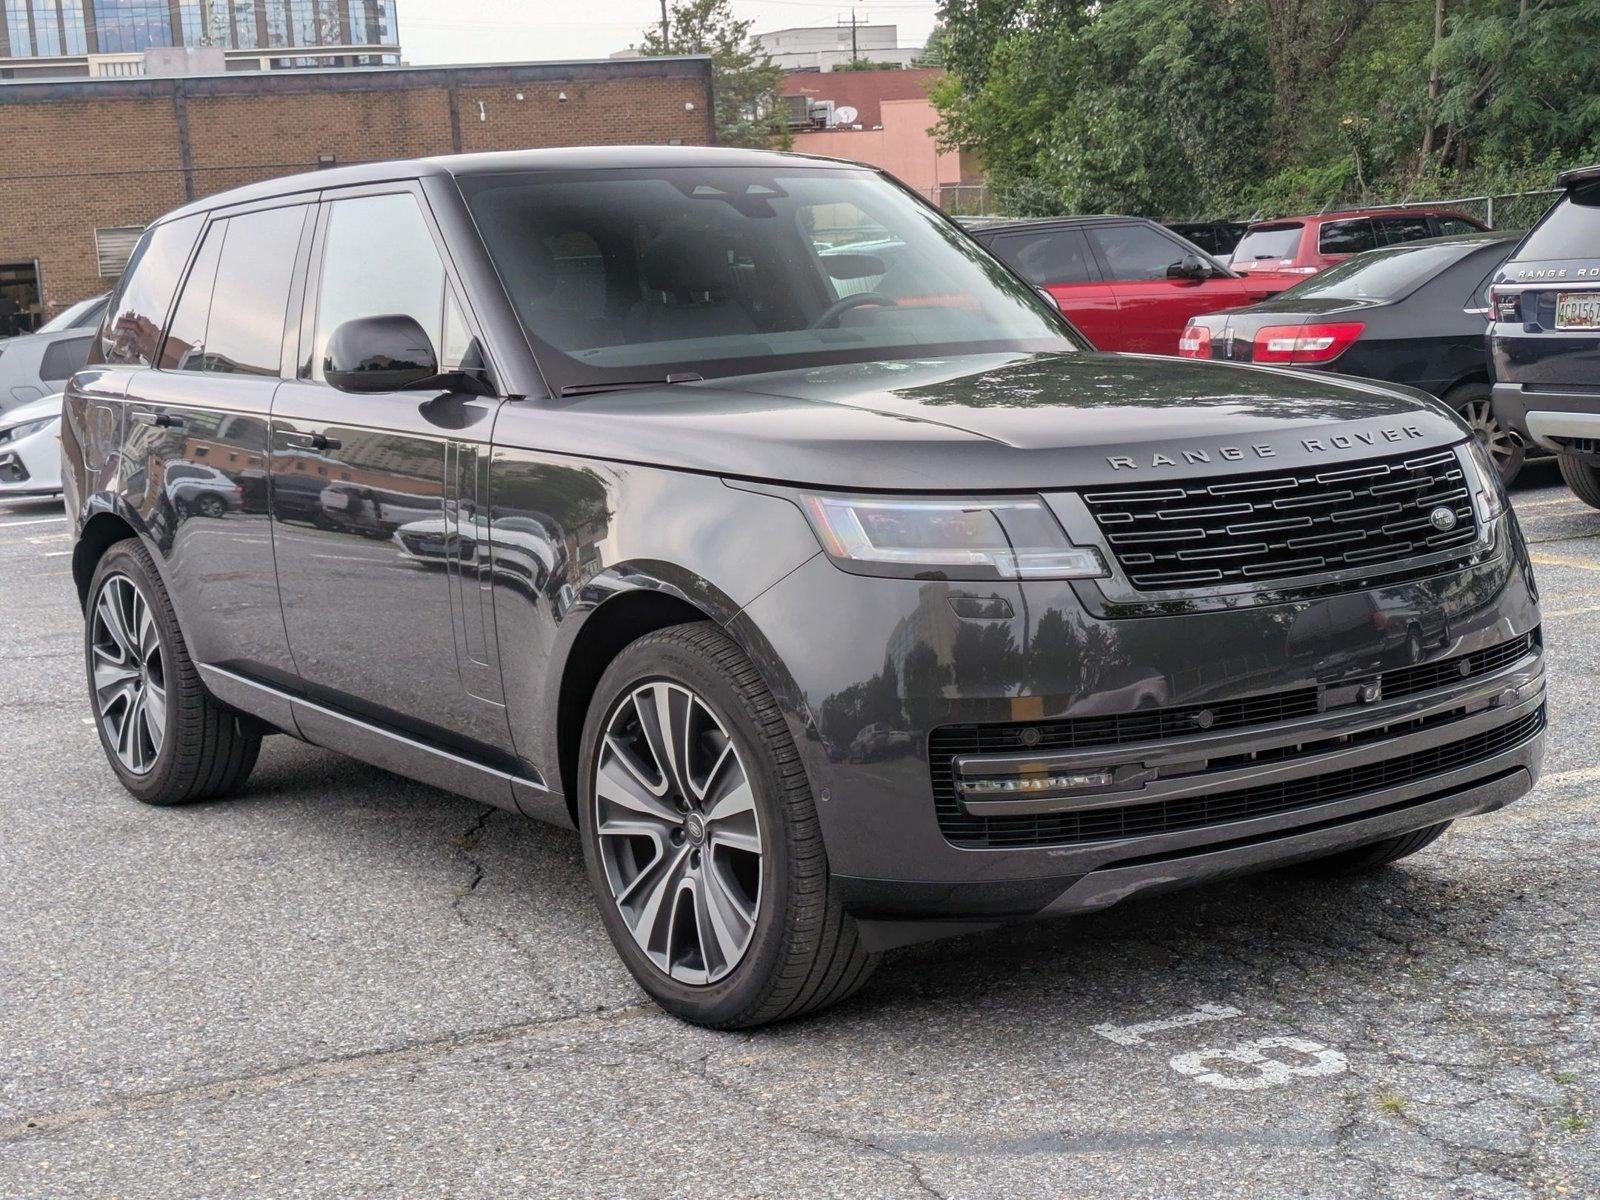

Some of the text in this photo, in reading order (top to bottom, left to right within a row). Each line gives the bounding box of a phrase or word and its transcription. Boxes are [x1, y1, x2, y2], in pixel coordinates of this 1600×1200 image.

[1519, 269, 1567, 278] RANGE
[1106, 425, 1425, 470] RANGE ROVER
